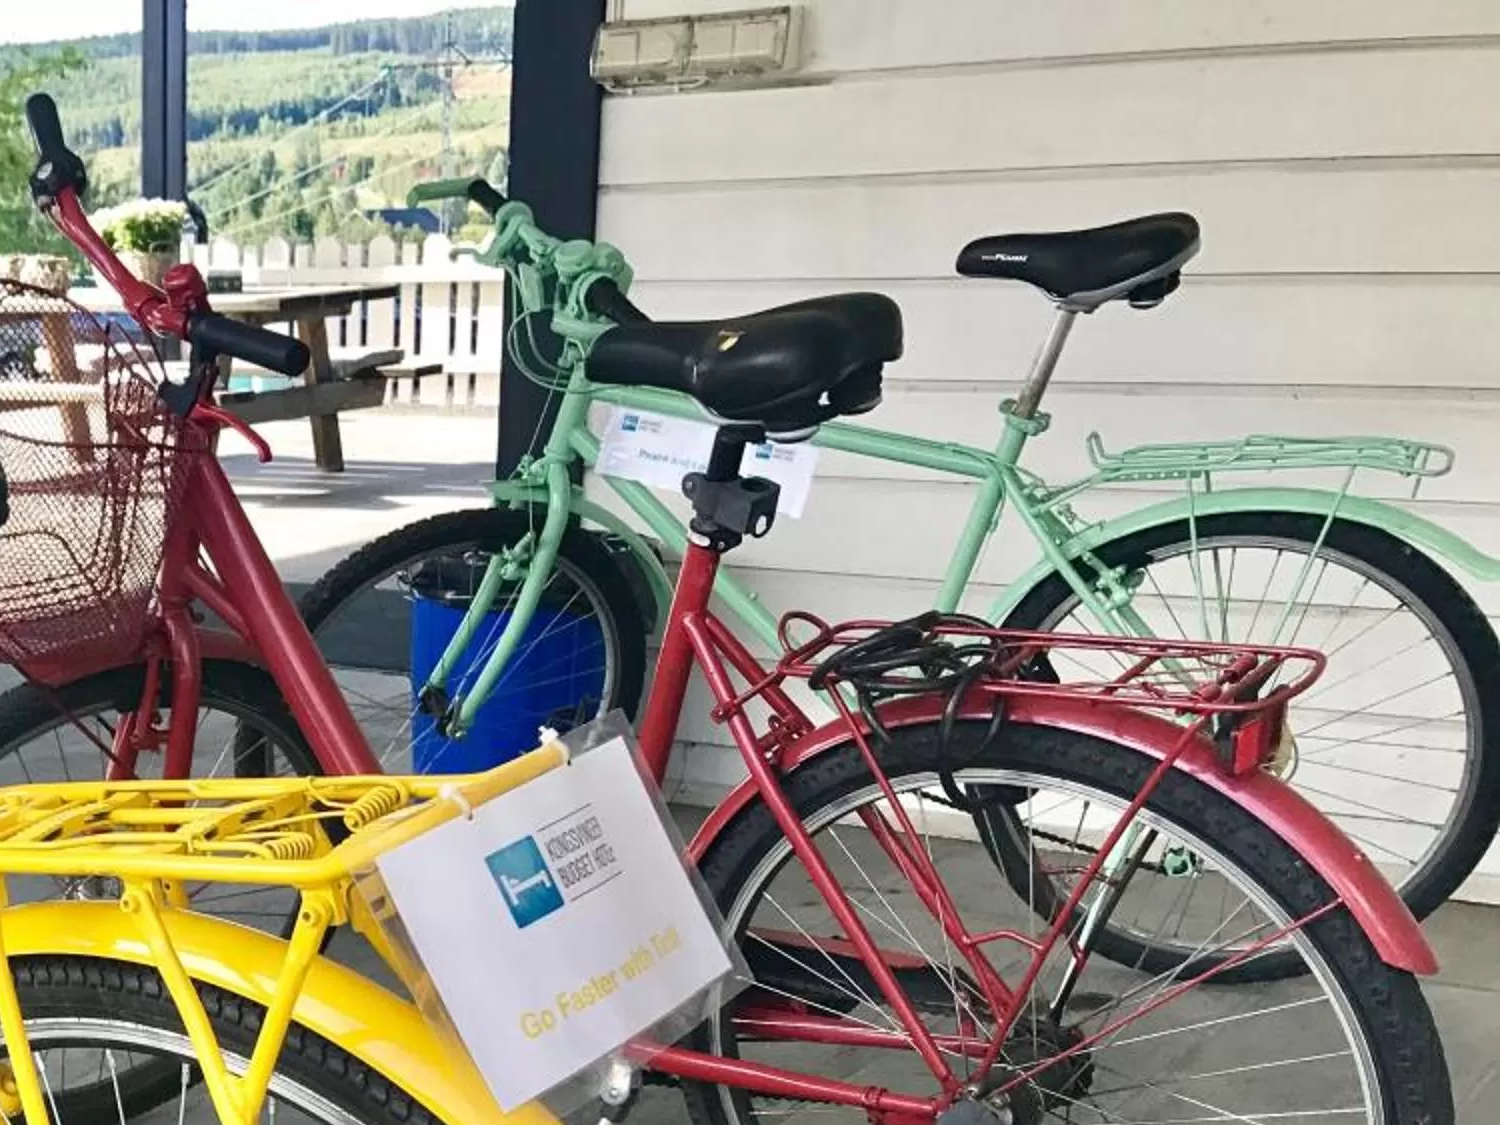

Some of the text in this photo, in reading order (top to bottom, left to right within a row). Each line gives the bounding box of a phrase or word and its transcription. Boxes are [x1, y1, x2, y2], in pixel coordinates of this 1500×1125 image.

[557, 852, 597, 889] BUDGET
[520, 1008, 556, 1040] Go
[555, 968, 620, 1020] Faster
